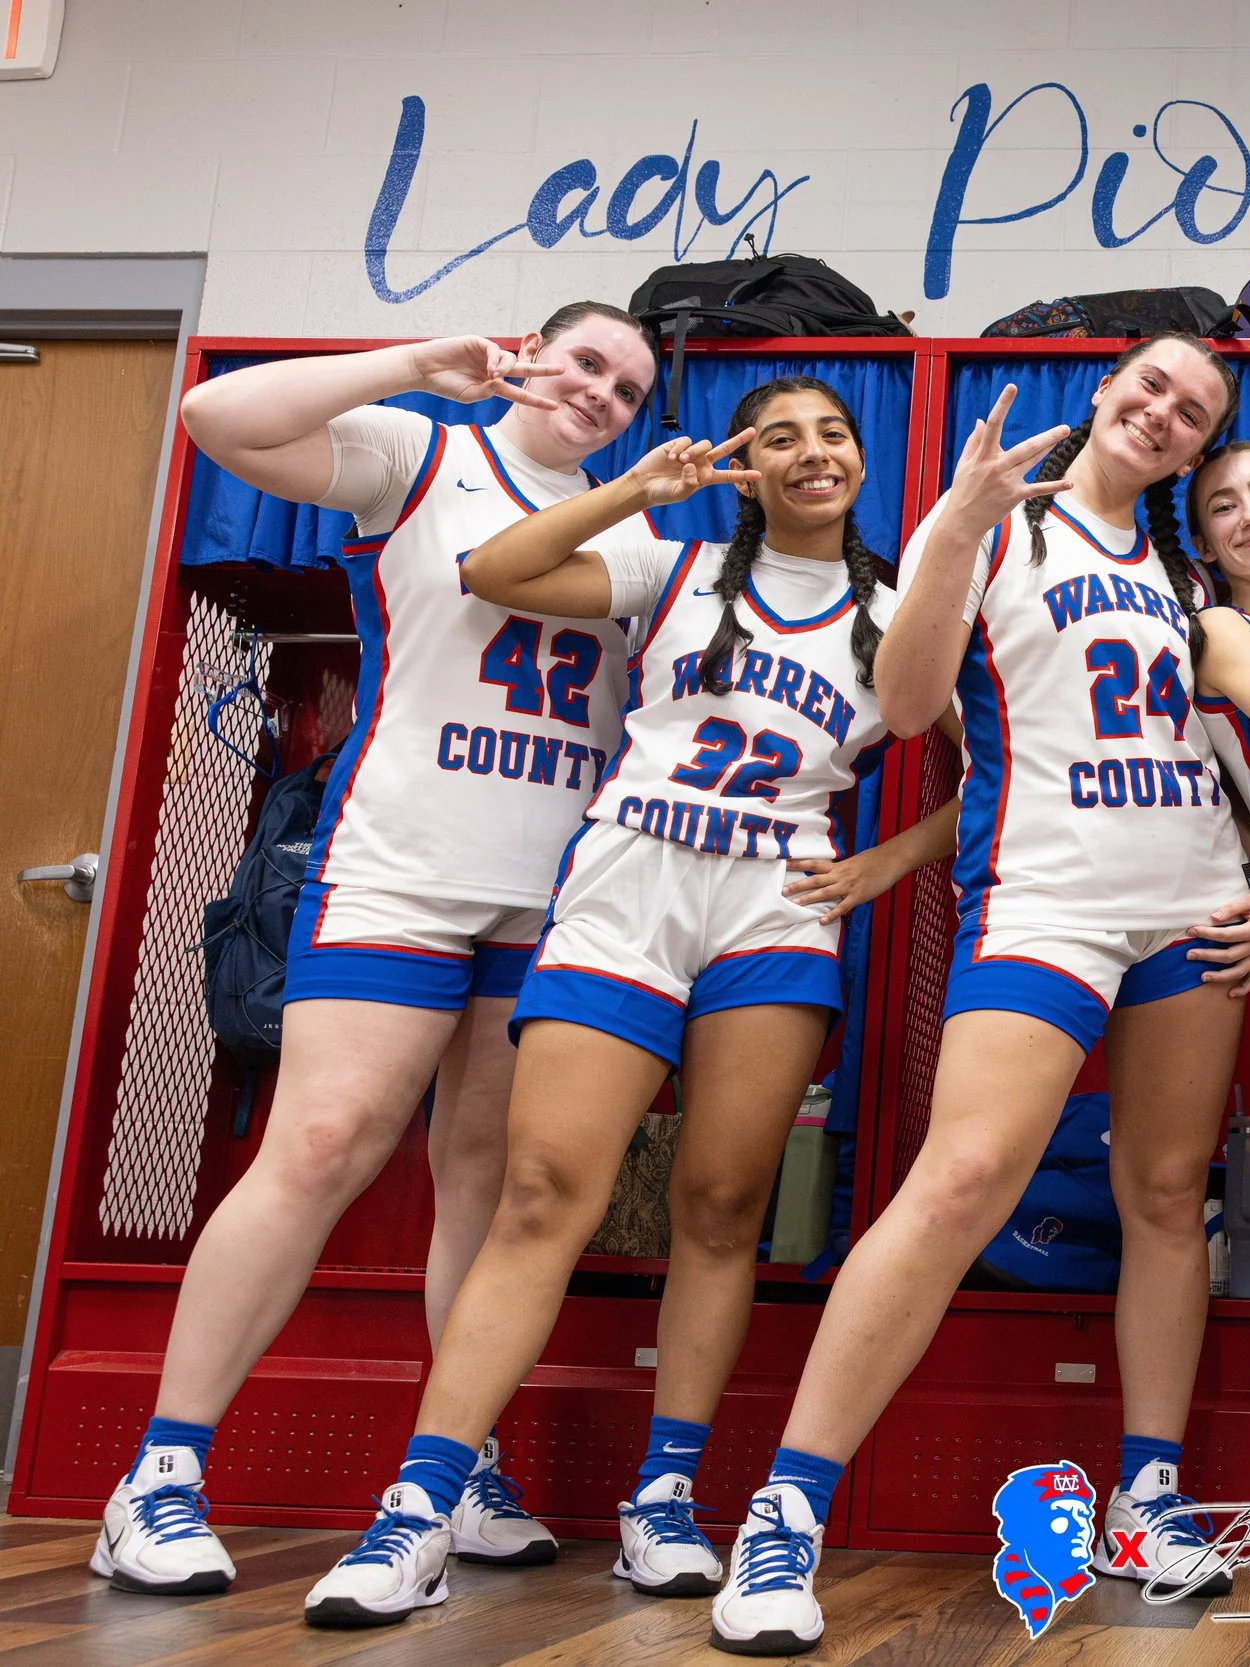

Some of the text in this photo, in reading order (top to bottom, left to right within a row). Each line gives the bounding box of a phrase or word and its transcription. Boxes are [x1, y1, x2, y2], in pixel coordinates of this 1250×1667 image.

[364, 95, 811, 304] Lady
[1043, 573, 1190, 645] WARRE
[479, 615, 603, 729] 42
[672, 648, 857, 748] WARREN
[1085, 638, 1191, 741] 24
[668, 716, 803, 803] 32
[617, 796, 800, 860] COUNTY
[1011, 1229, 1050, 1257] BASKETBALL
